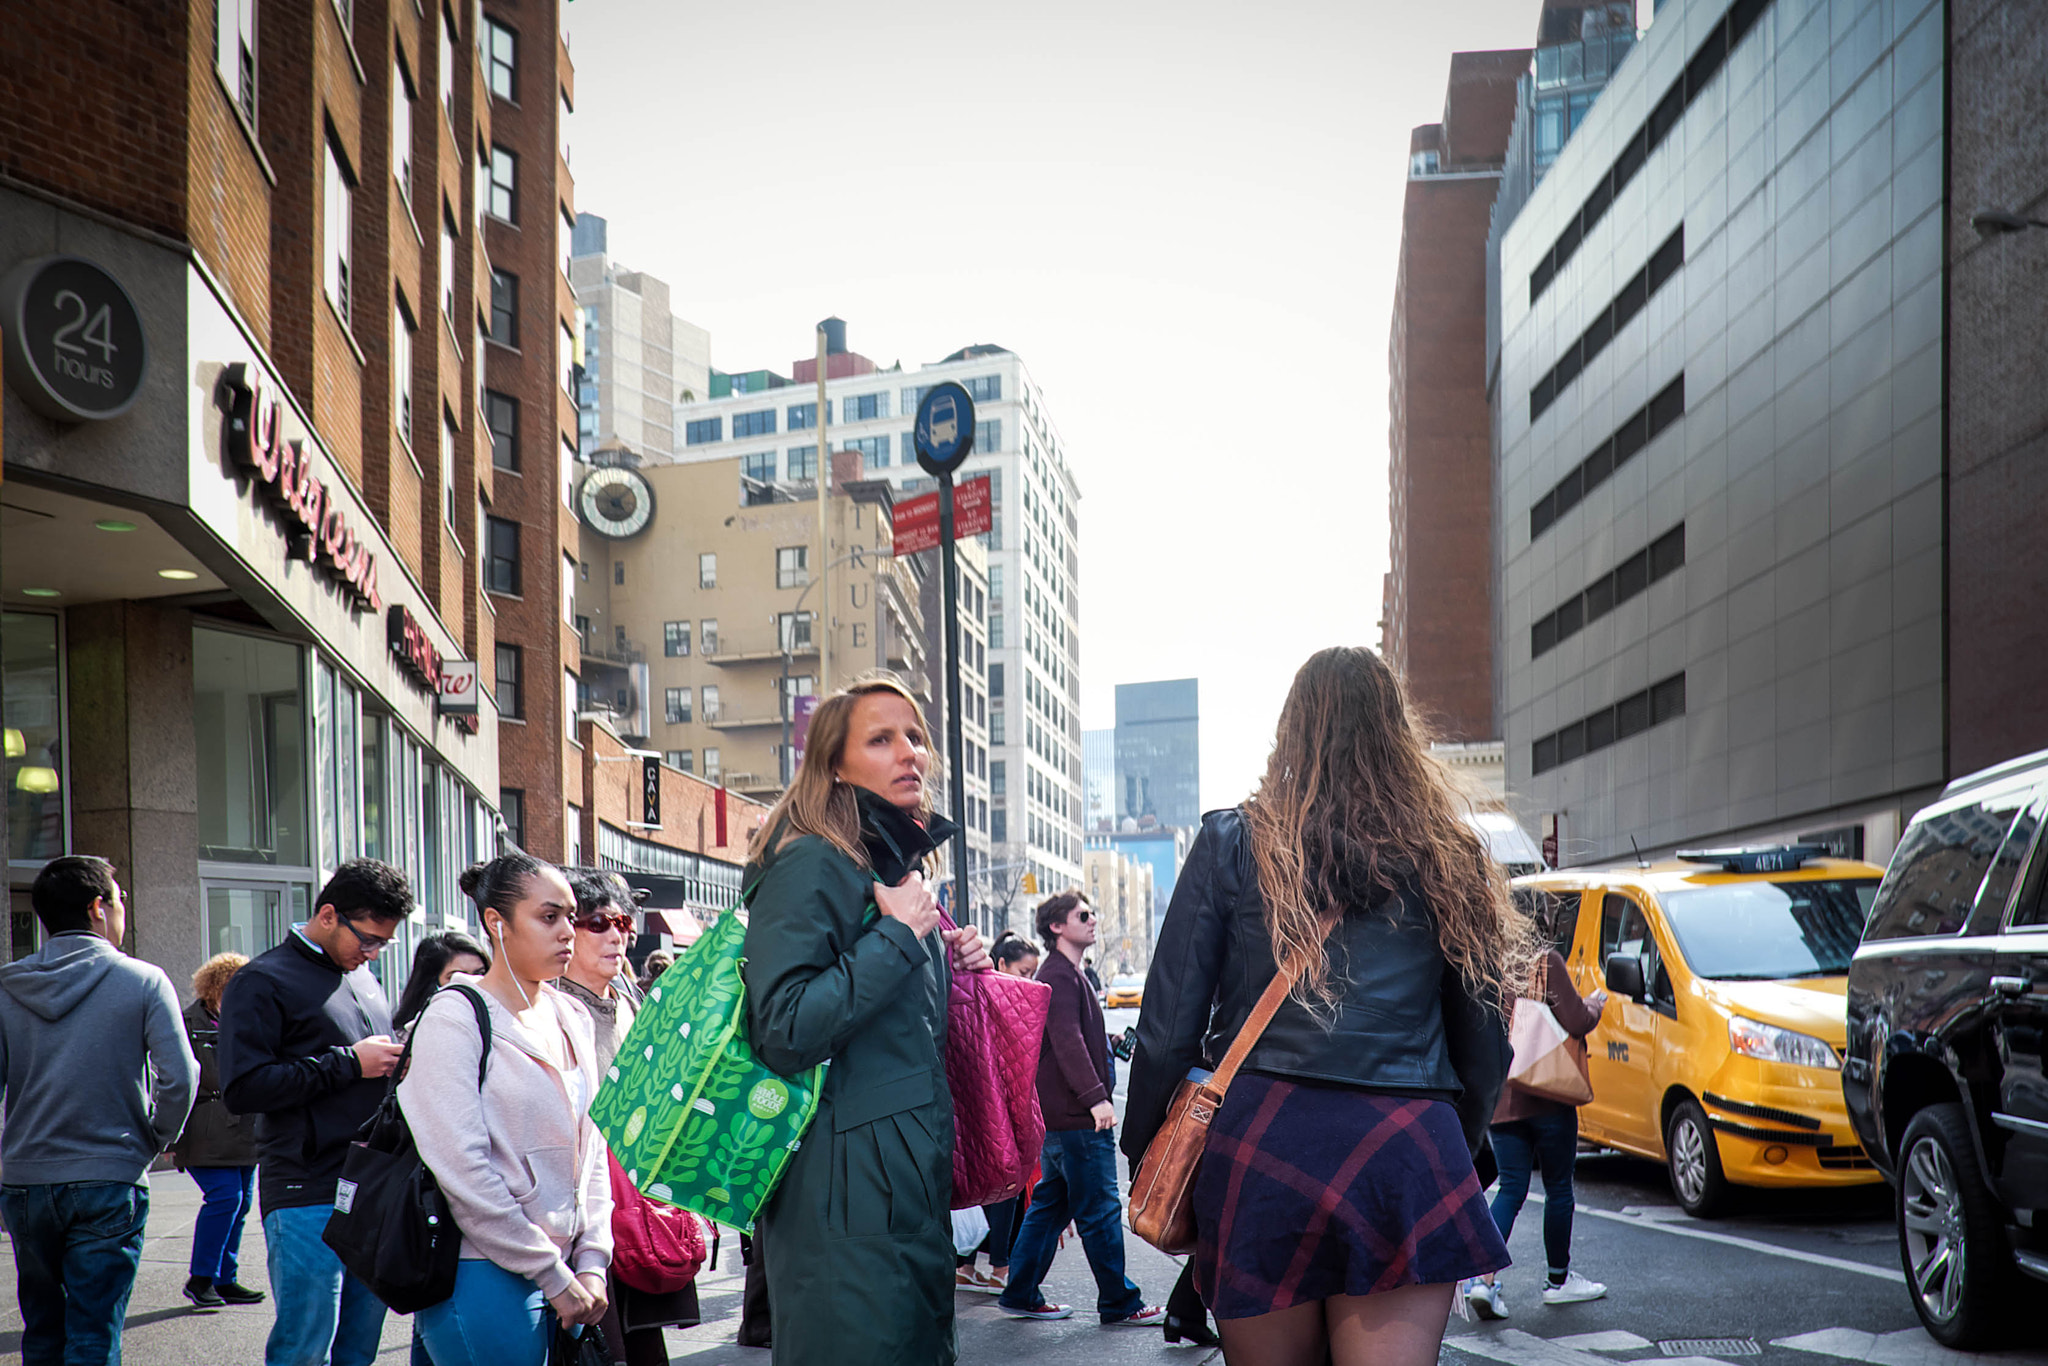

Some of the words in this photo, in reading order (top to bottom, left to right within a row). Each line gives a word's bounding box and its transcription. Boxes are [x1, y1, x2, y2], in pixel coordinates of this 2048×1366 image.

[53, 289, 119, 364] 24
[54, 347, 114, 389] hours
[236, 361, 381, 615] Walgreens
[956, 486, 988, 505] STANDING
[966, 481, 977, 491] NO
[956, 515, 988, 533] STANDING
[967, 509, 977, 519] NO
[850, 504, 868, 649] TRUE
[646, 766, 657, 821] CAVA
[1607, 1040, 1629, 1062] NYC
[752, 1093, 780, 1113] FOODS
[756, 1086, 785, 1103] WHOLE
